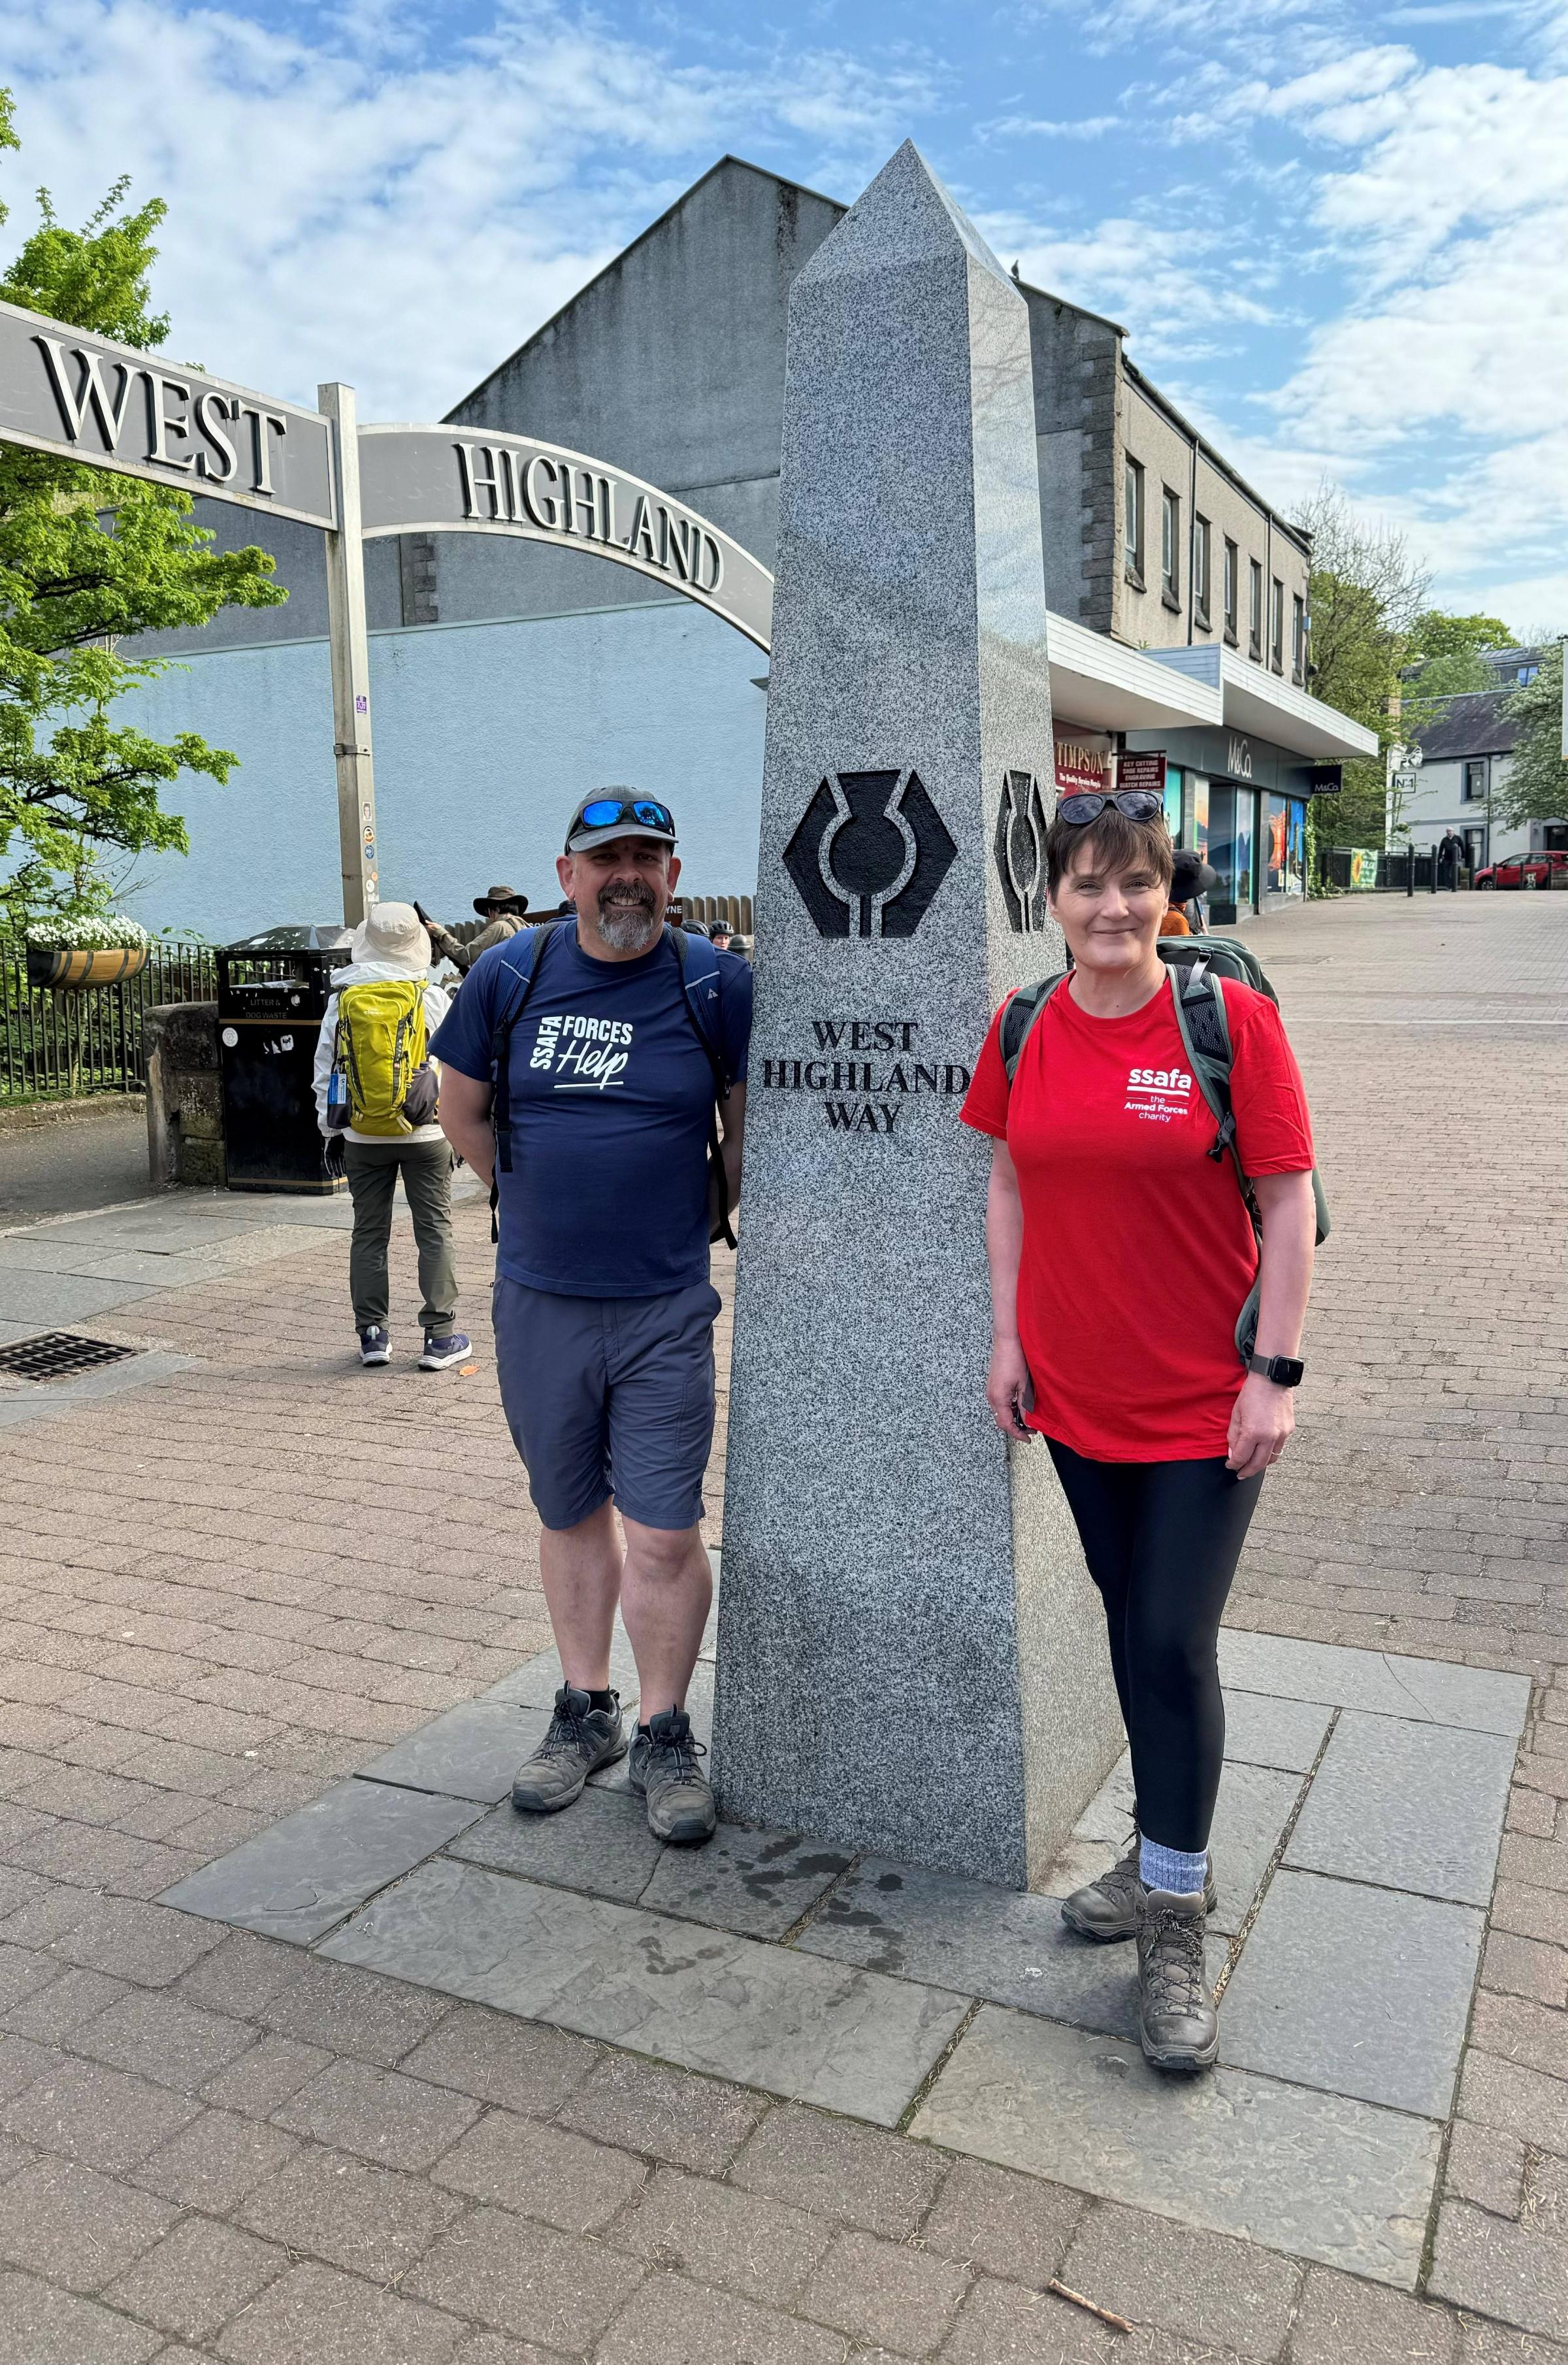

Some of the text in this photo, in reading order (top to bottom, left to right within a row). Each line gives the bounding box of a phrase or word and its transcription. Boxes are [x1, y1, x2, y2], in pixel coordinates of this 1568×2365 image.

[33, 334, 287, 495] WEST
[453, 442, 725, 594] HIGHLAND
[1056, 742, 1103, 774] TIMPSON
[530, 1016, 563, 1070] SSAFA
[563, 1015, 633, 1045] FORCES
[812, 1021, 918, 1052] WEST
[556, 1040, 629, 1090] Help
[762, 1059, 971, 1095] HIGHLAND
[1128, 1068, 1192, 1090] ssafa
[1124, 1102, 1188, 1115] Armed Forces
[1150, 1095, 1166, 1104] the
[823, 1102, 903, 1133] WAY
[1139, 1112, 1171, 1123] charity
